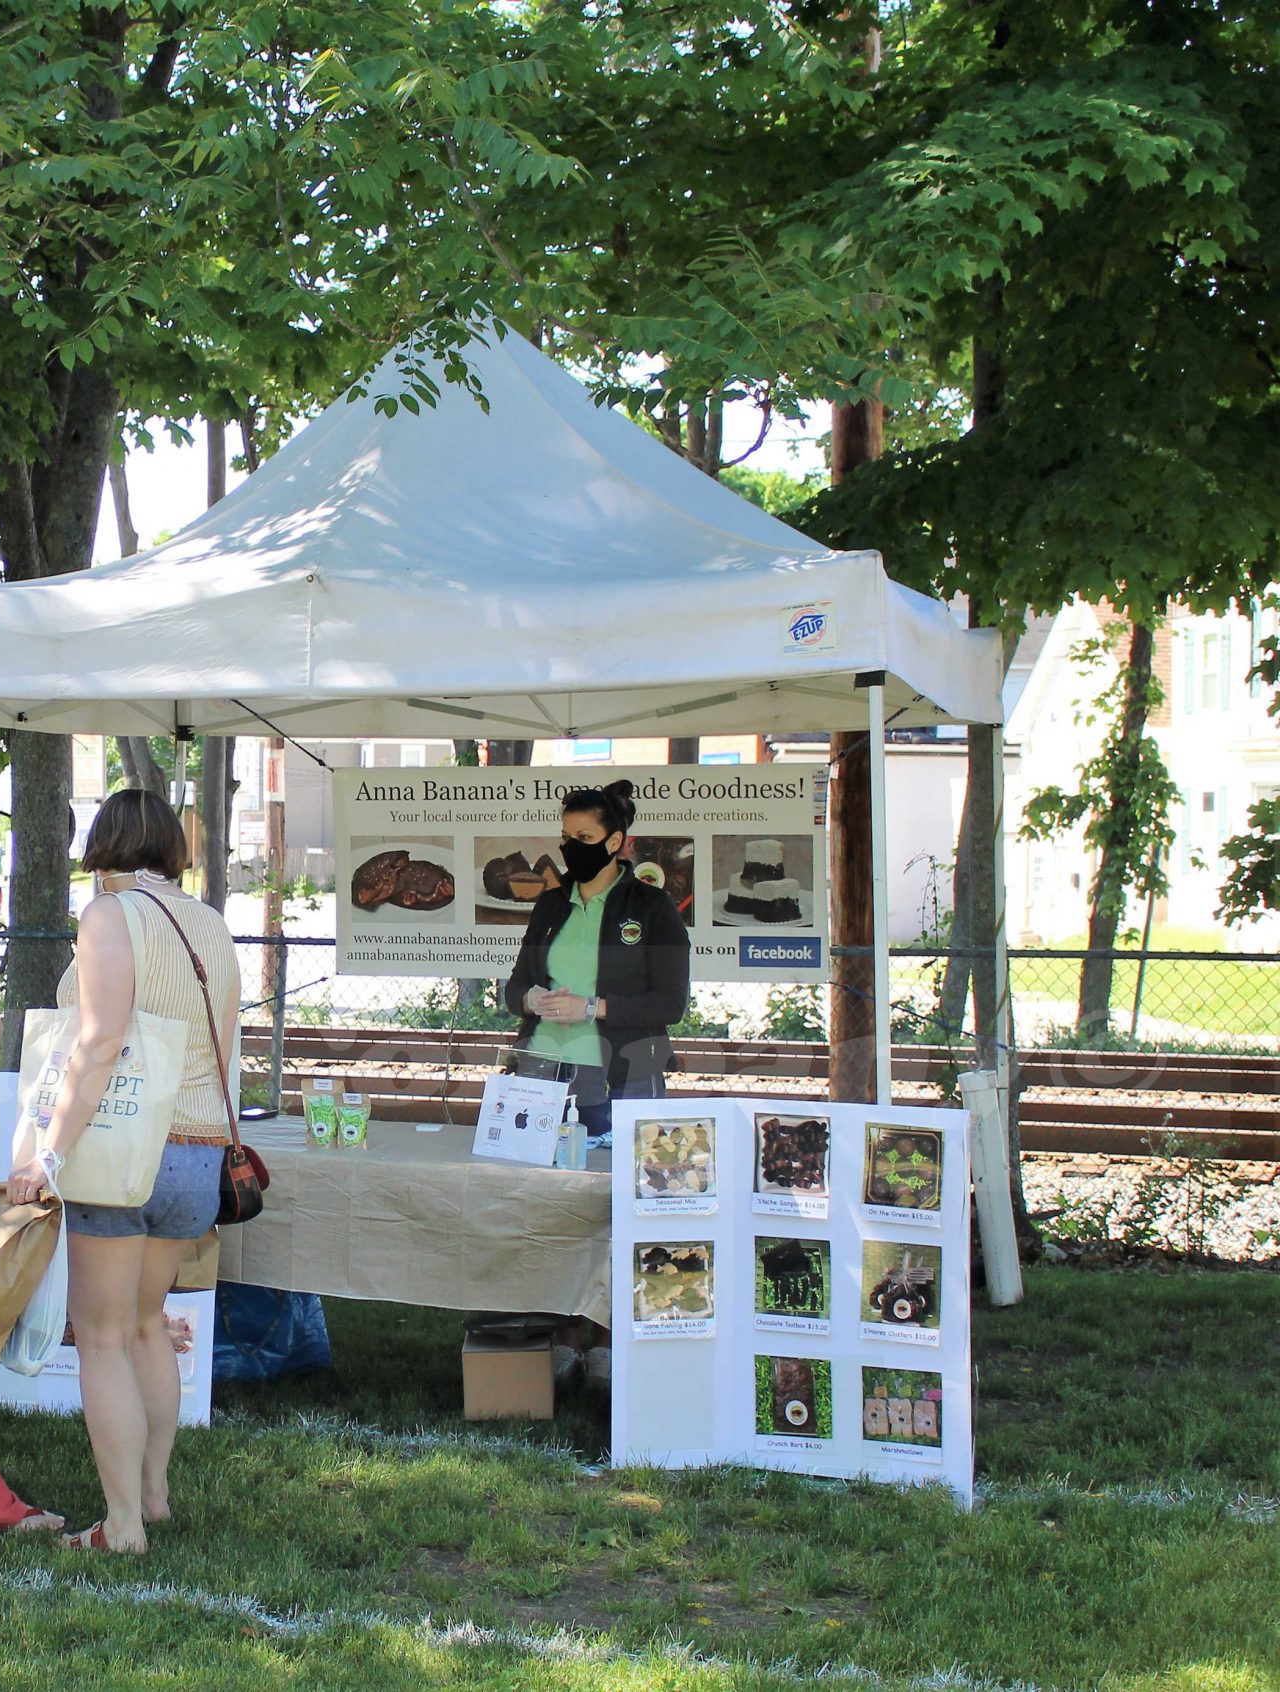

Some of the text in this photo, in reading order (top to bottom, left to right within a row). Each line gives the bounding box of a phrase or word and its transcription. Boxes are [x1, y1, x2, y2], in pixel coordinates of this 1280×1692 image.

[355, 776, 805, 801] Anna Banana's Homade Goodness!
[390, 808, 768, 823] Your local source for delicio omemade creations.
[353, 933, 523, 946] www.annabananashomema
[347, 948, 519, 965] annabananashomemadegoo
[695, 944, 813, 960] us on facebook
[880, 1209, 889, 1217] the
[891, 1211, 910, 1219] Green
[755, 1318, 783, 1327] Chocolate
[888, 1330, 913, 1339] Clusters
